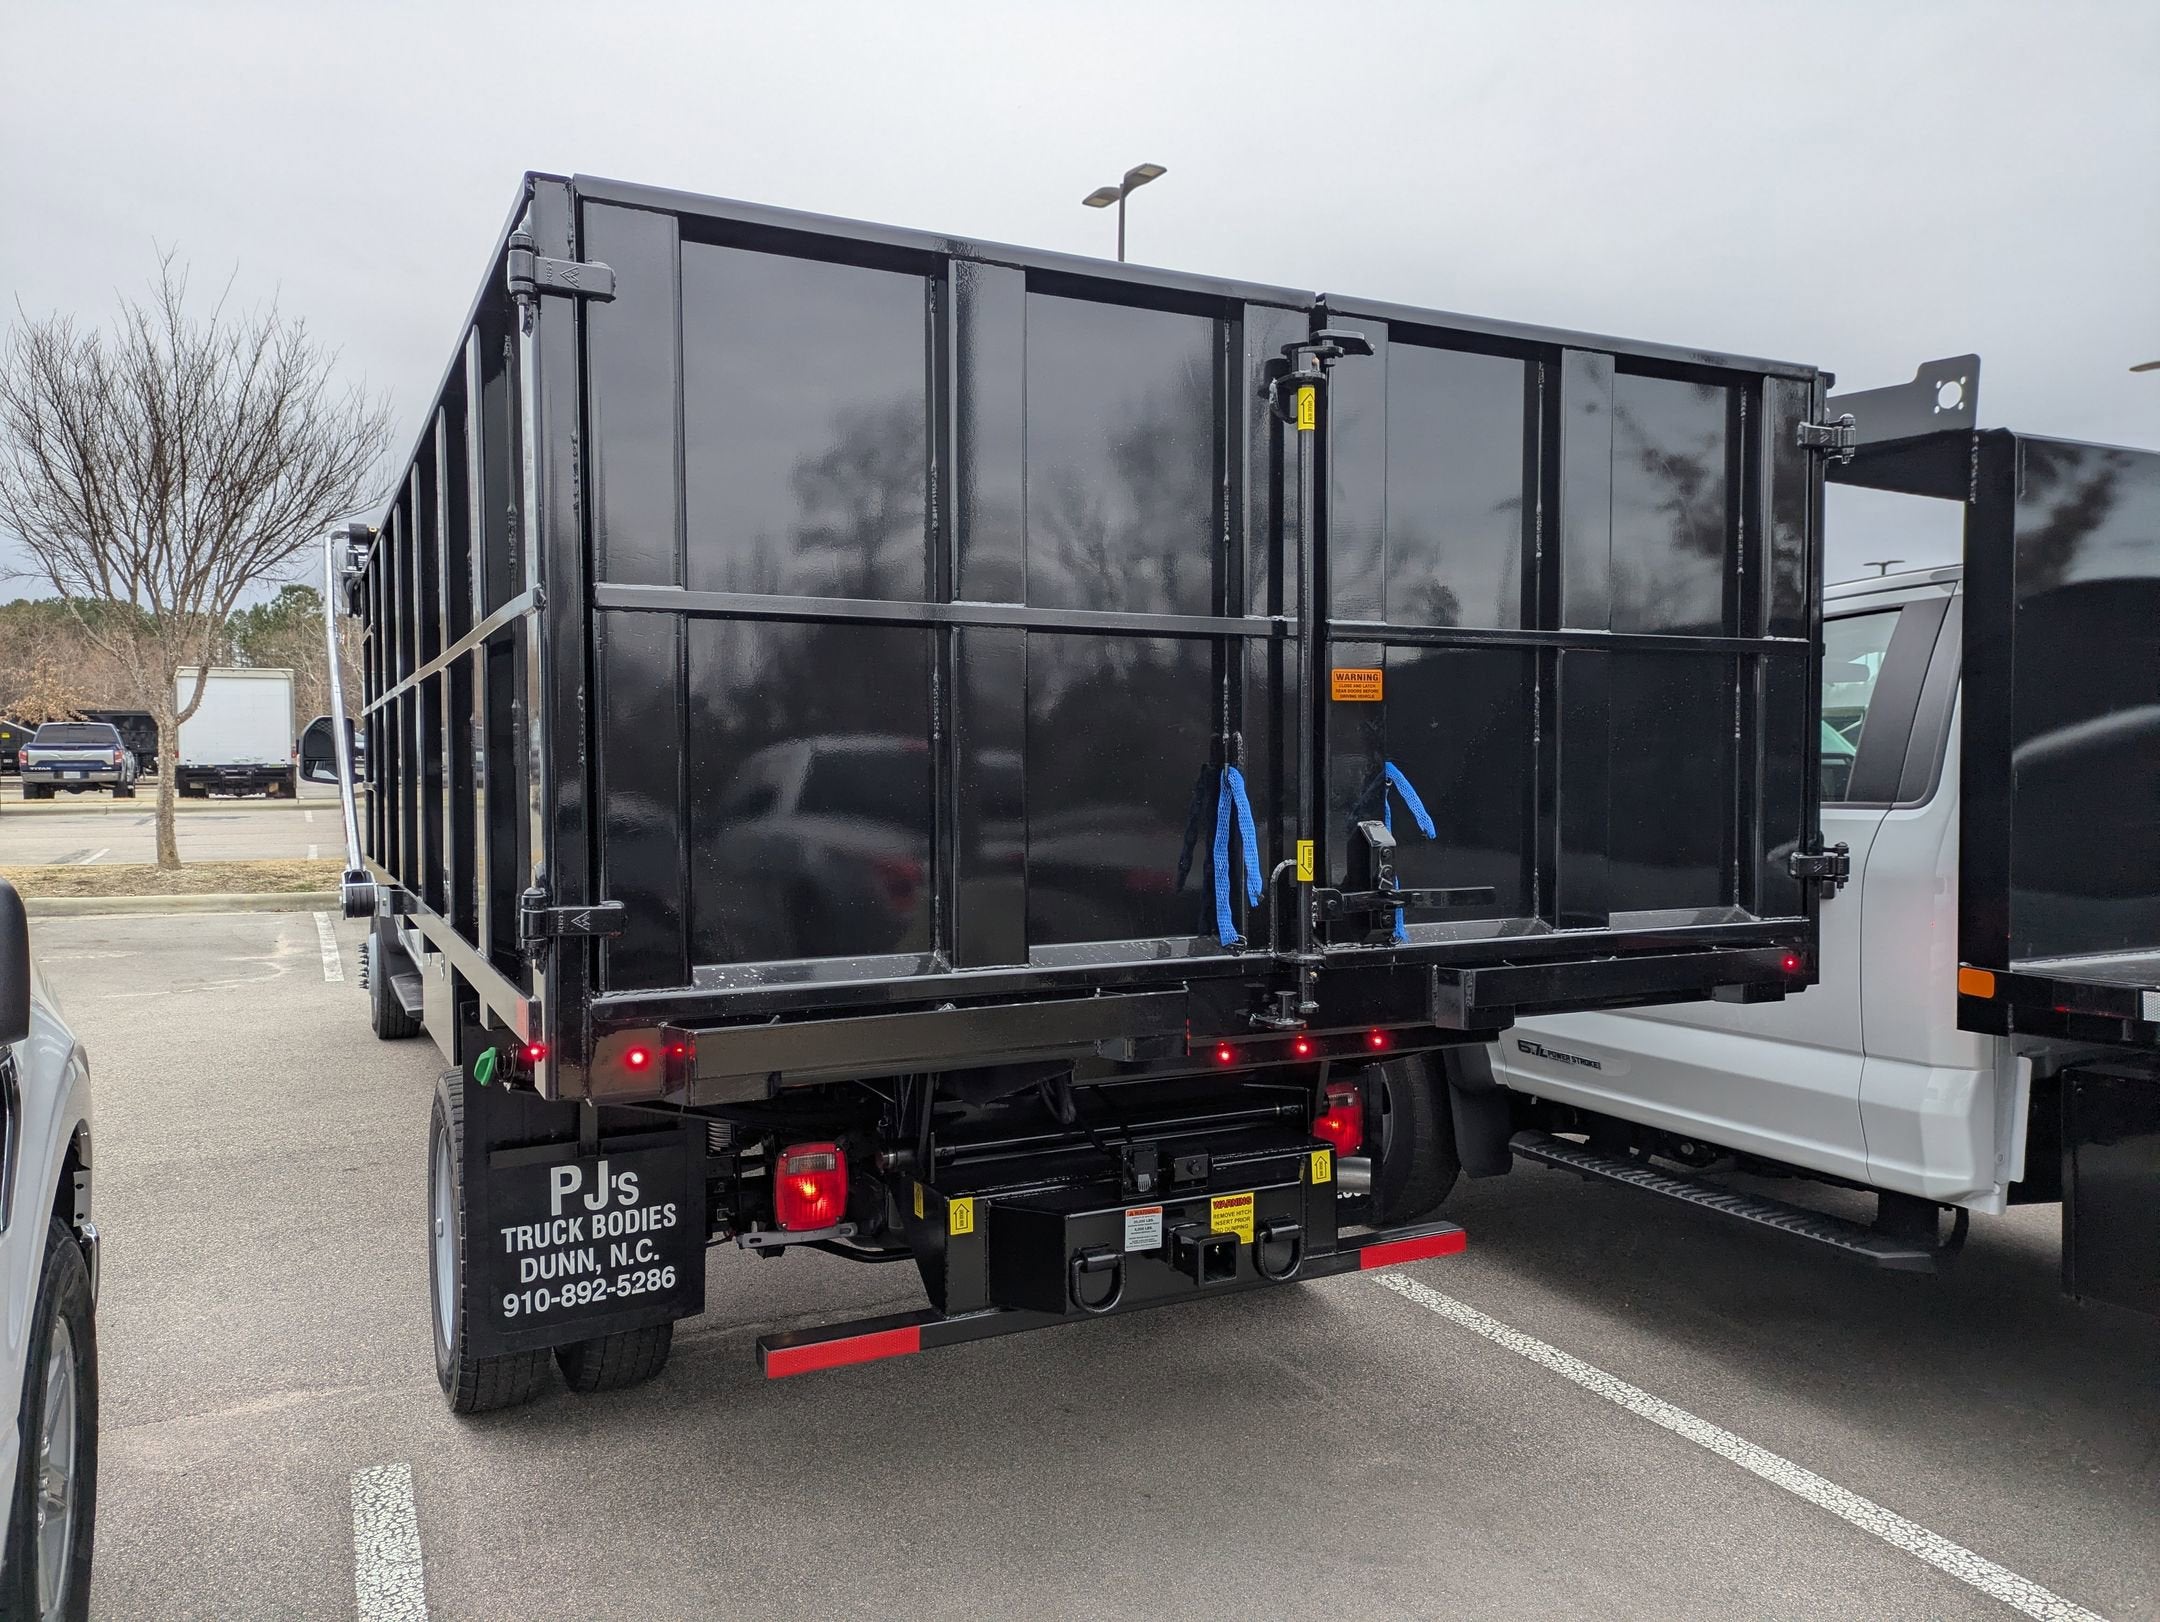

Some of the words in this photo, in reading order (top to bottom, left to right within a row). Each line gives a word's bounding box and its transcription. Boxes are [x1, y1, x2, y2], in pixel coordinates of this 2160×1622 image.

[1335, 673, 1379, 681] WARNING
[1517, 1039, 1548, 1058] 6.7L
[1548, 1050, 1571, 1062] POWER
[1570, 1055, 1602, 1070] STROKE
[550, 1160, 640, 1216] PJ's
[1212, 1196, 1252, 1209] WARNING
[1212, 1211, 1236, 1220] REMOVE
[1213, 1219, 1233, 1227] INSERT
[1233, 1216, 1251, 1224] PRIOR
[500, 1216, 584, 1253] TRUCK
[592, 1203, 677, 1239] BODIES
[1224, 1223, 1249, 1232] DUMPING
[520, 1248, 602, 1284] DUNN,
[610, 1238, 660, 1268] N.C.
[502, 1266, 676, 1318] 910-892-5286
